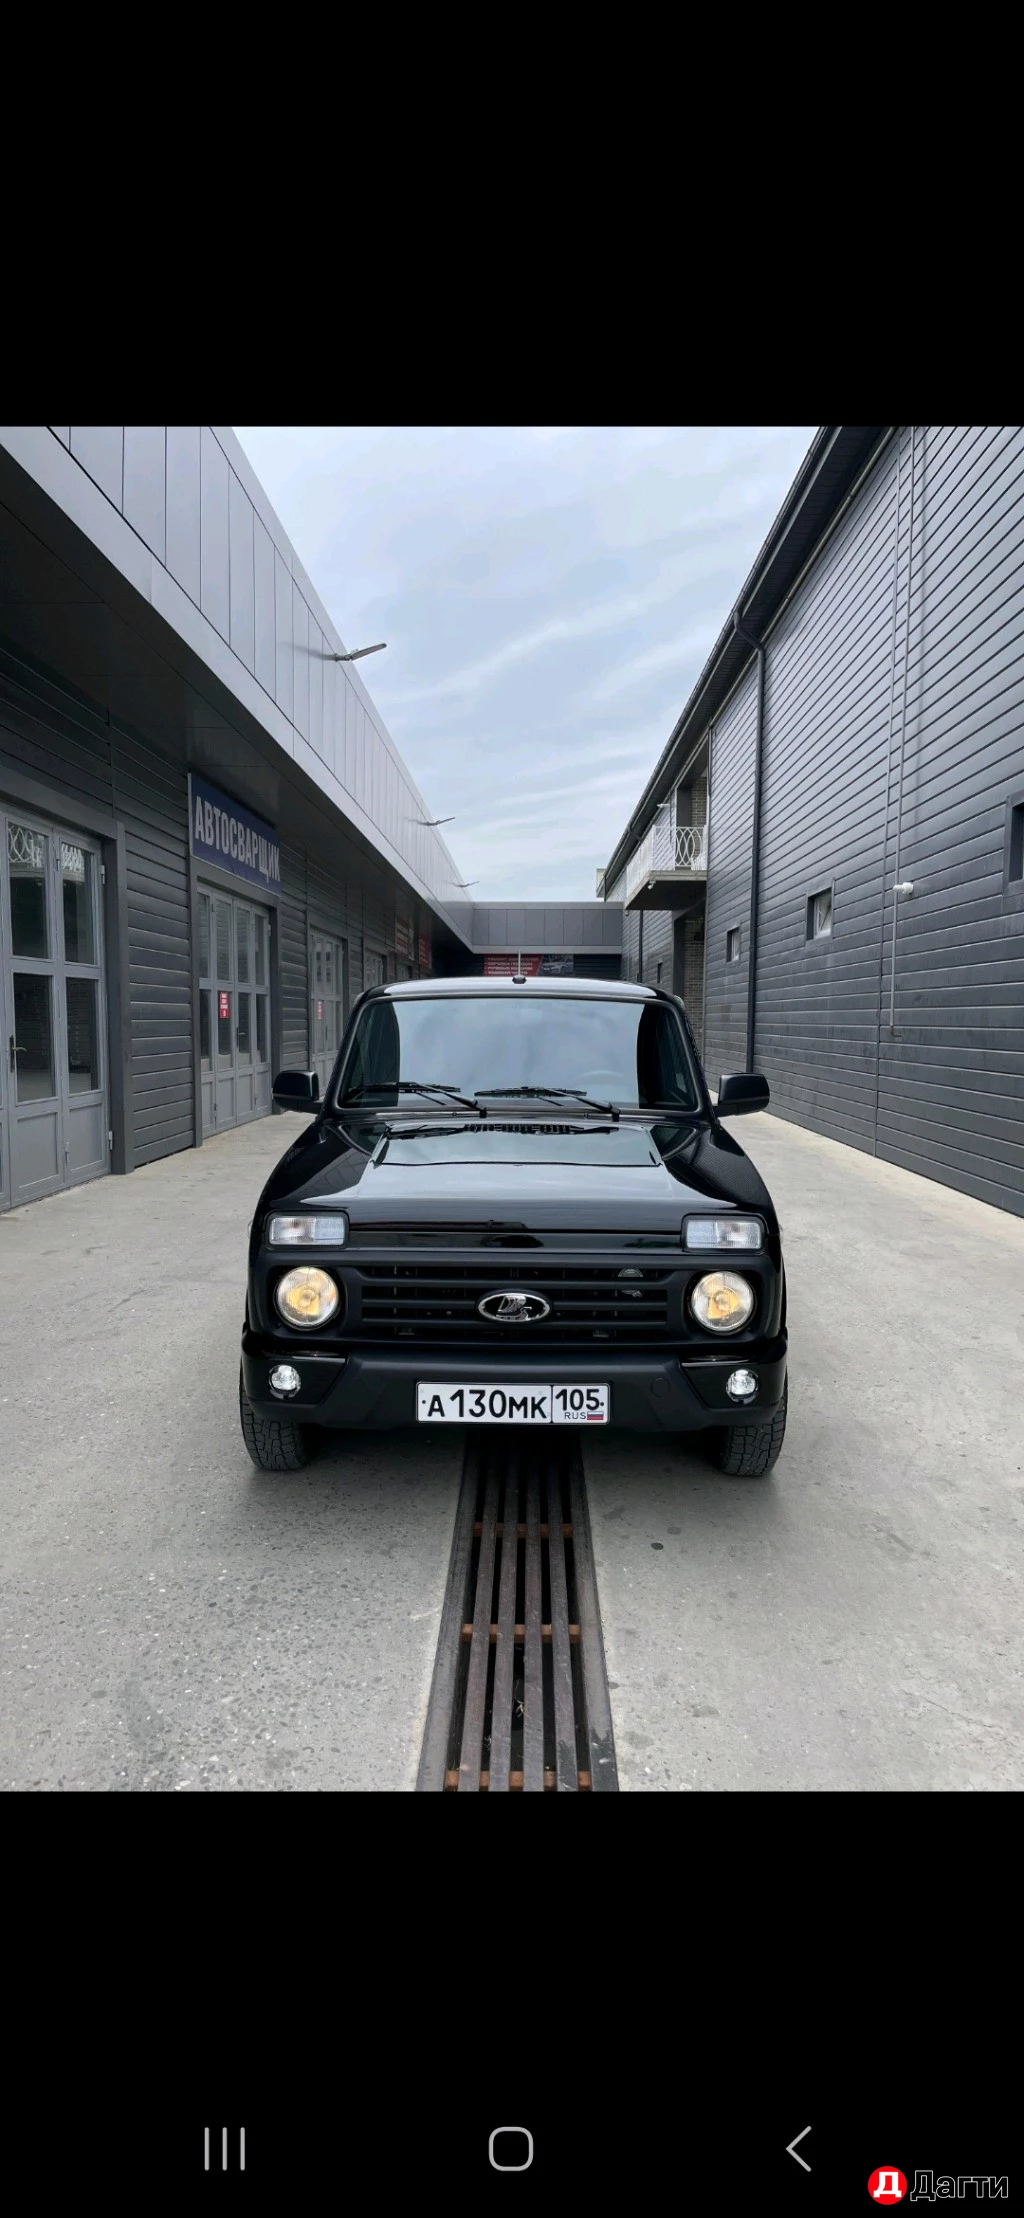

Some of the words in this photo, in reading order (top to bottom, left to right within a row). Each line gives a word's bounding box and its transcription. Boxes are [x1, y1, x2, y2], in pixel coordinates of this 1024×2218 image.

[195, 795, 280, 883] АВТОСВАРЩИК
[555, 1388, 600, 1411] 105
[564, 1411, 586, 1420] RUS
